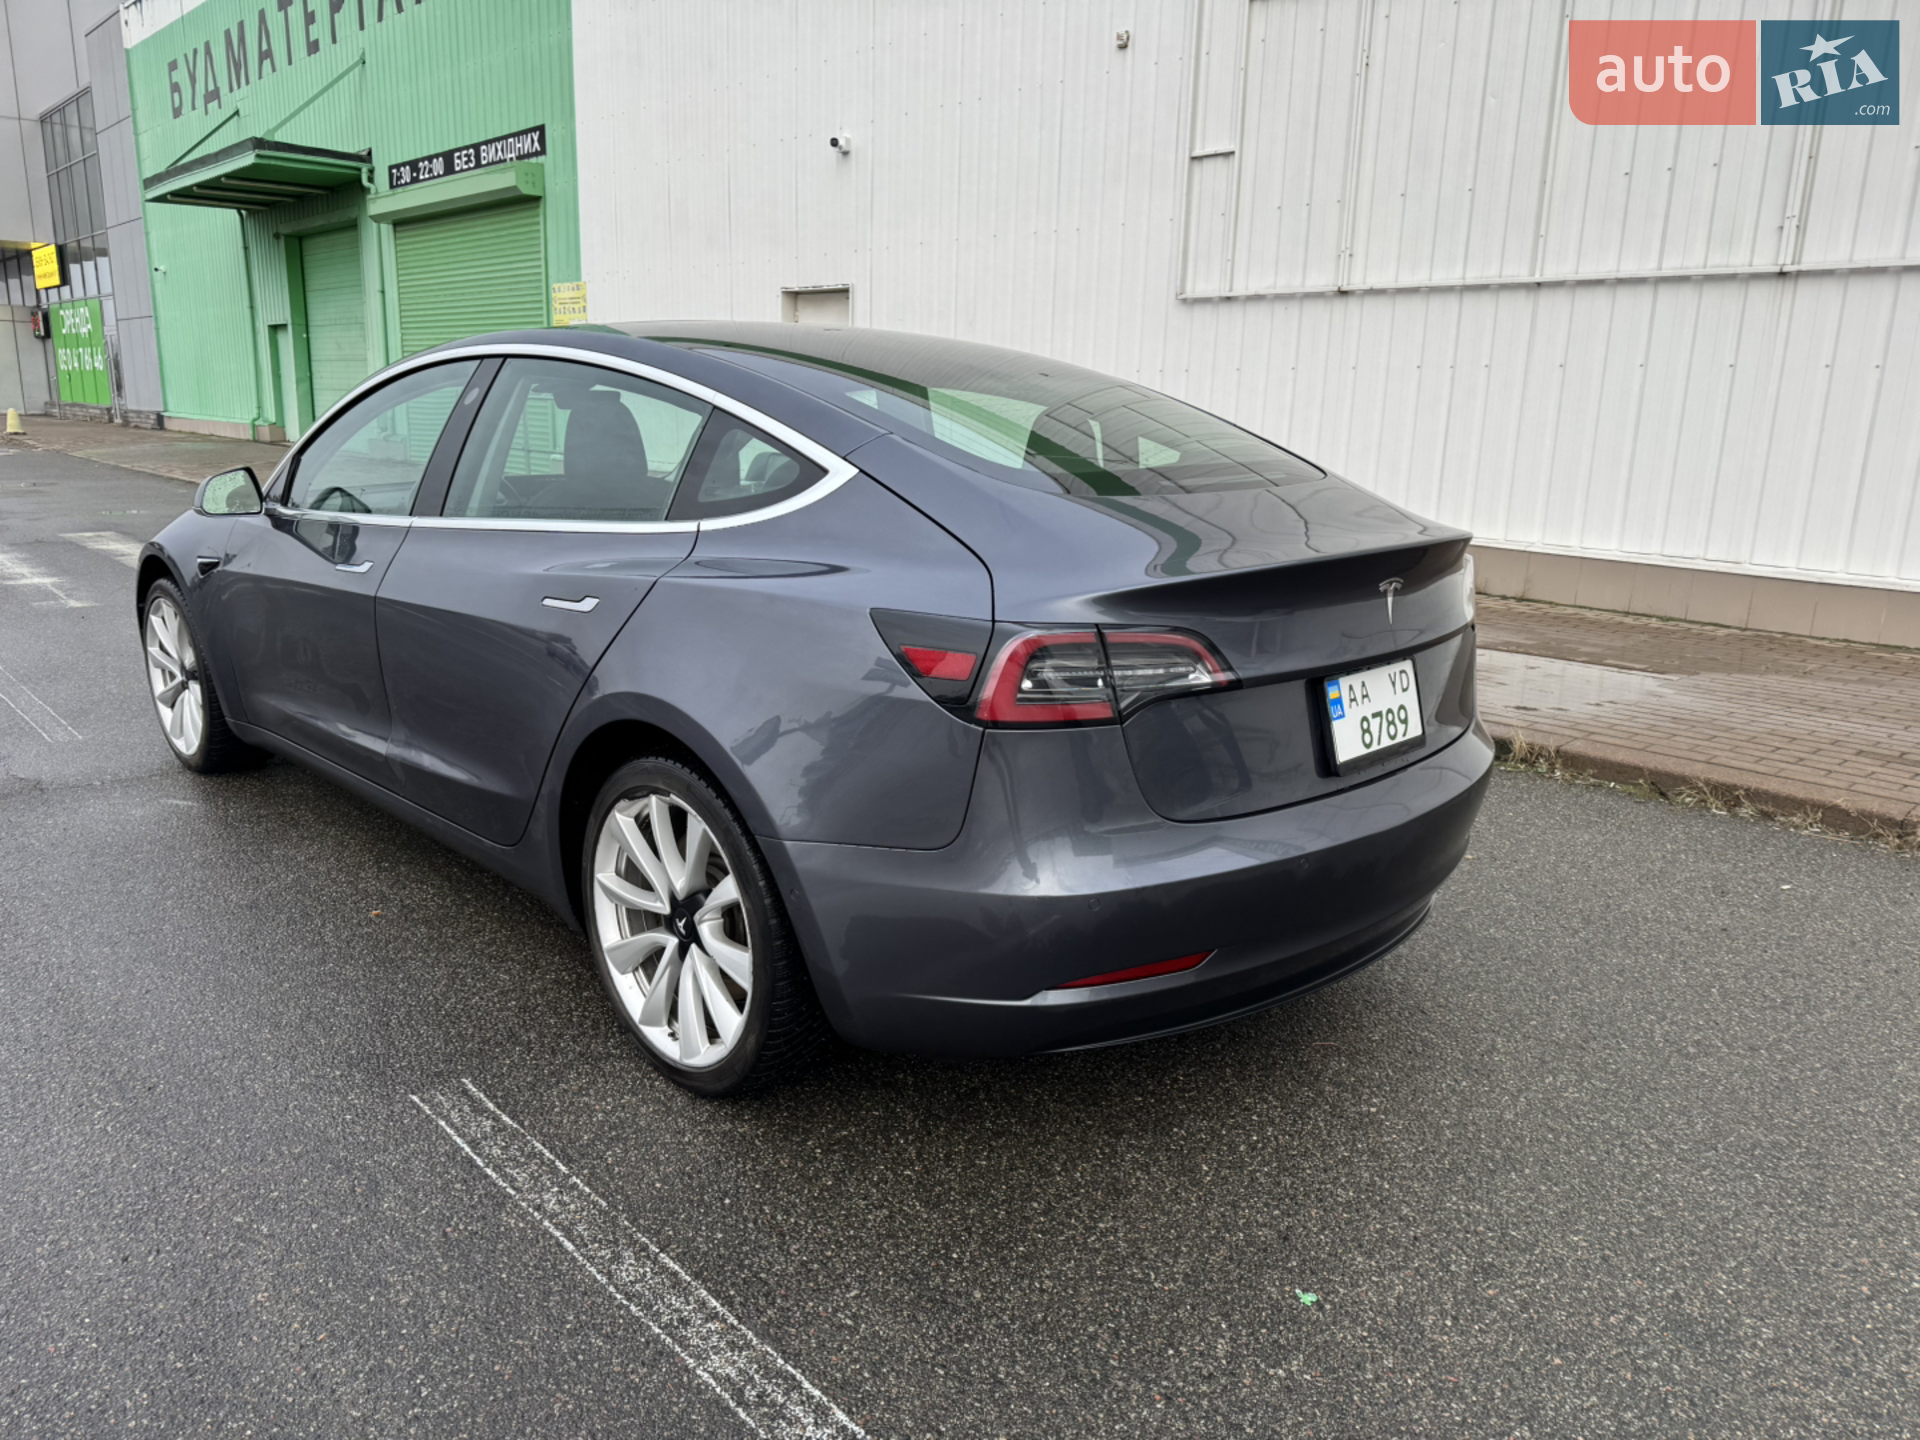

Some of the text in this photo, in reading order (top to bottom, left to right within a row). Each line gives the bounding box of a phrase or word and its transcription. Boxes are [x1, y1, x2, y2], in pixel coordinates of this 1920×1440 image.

[167, 0, 422, 119] БУДМАТЕР
[391, 165, 411, 186] 7:30
[418, 157, 445, 180] 22:00
[453, 149, 476, 171] БЕЗ
[480, 131, 541, 164] ВИХІДНИХ
[1331, 704, 1344, 718] UA
[1348, 669, 1410, 709] AA YD
[1360, 704, 1408, 750] 8789
